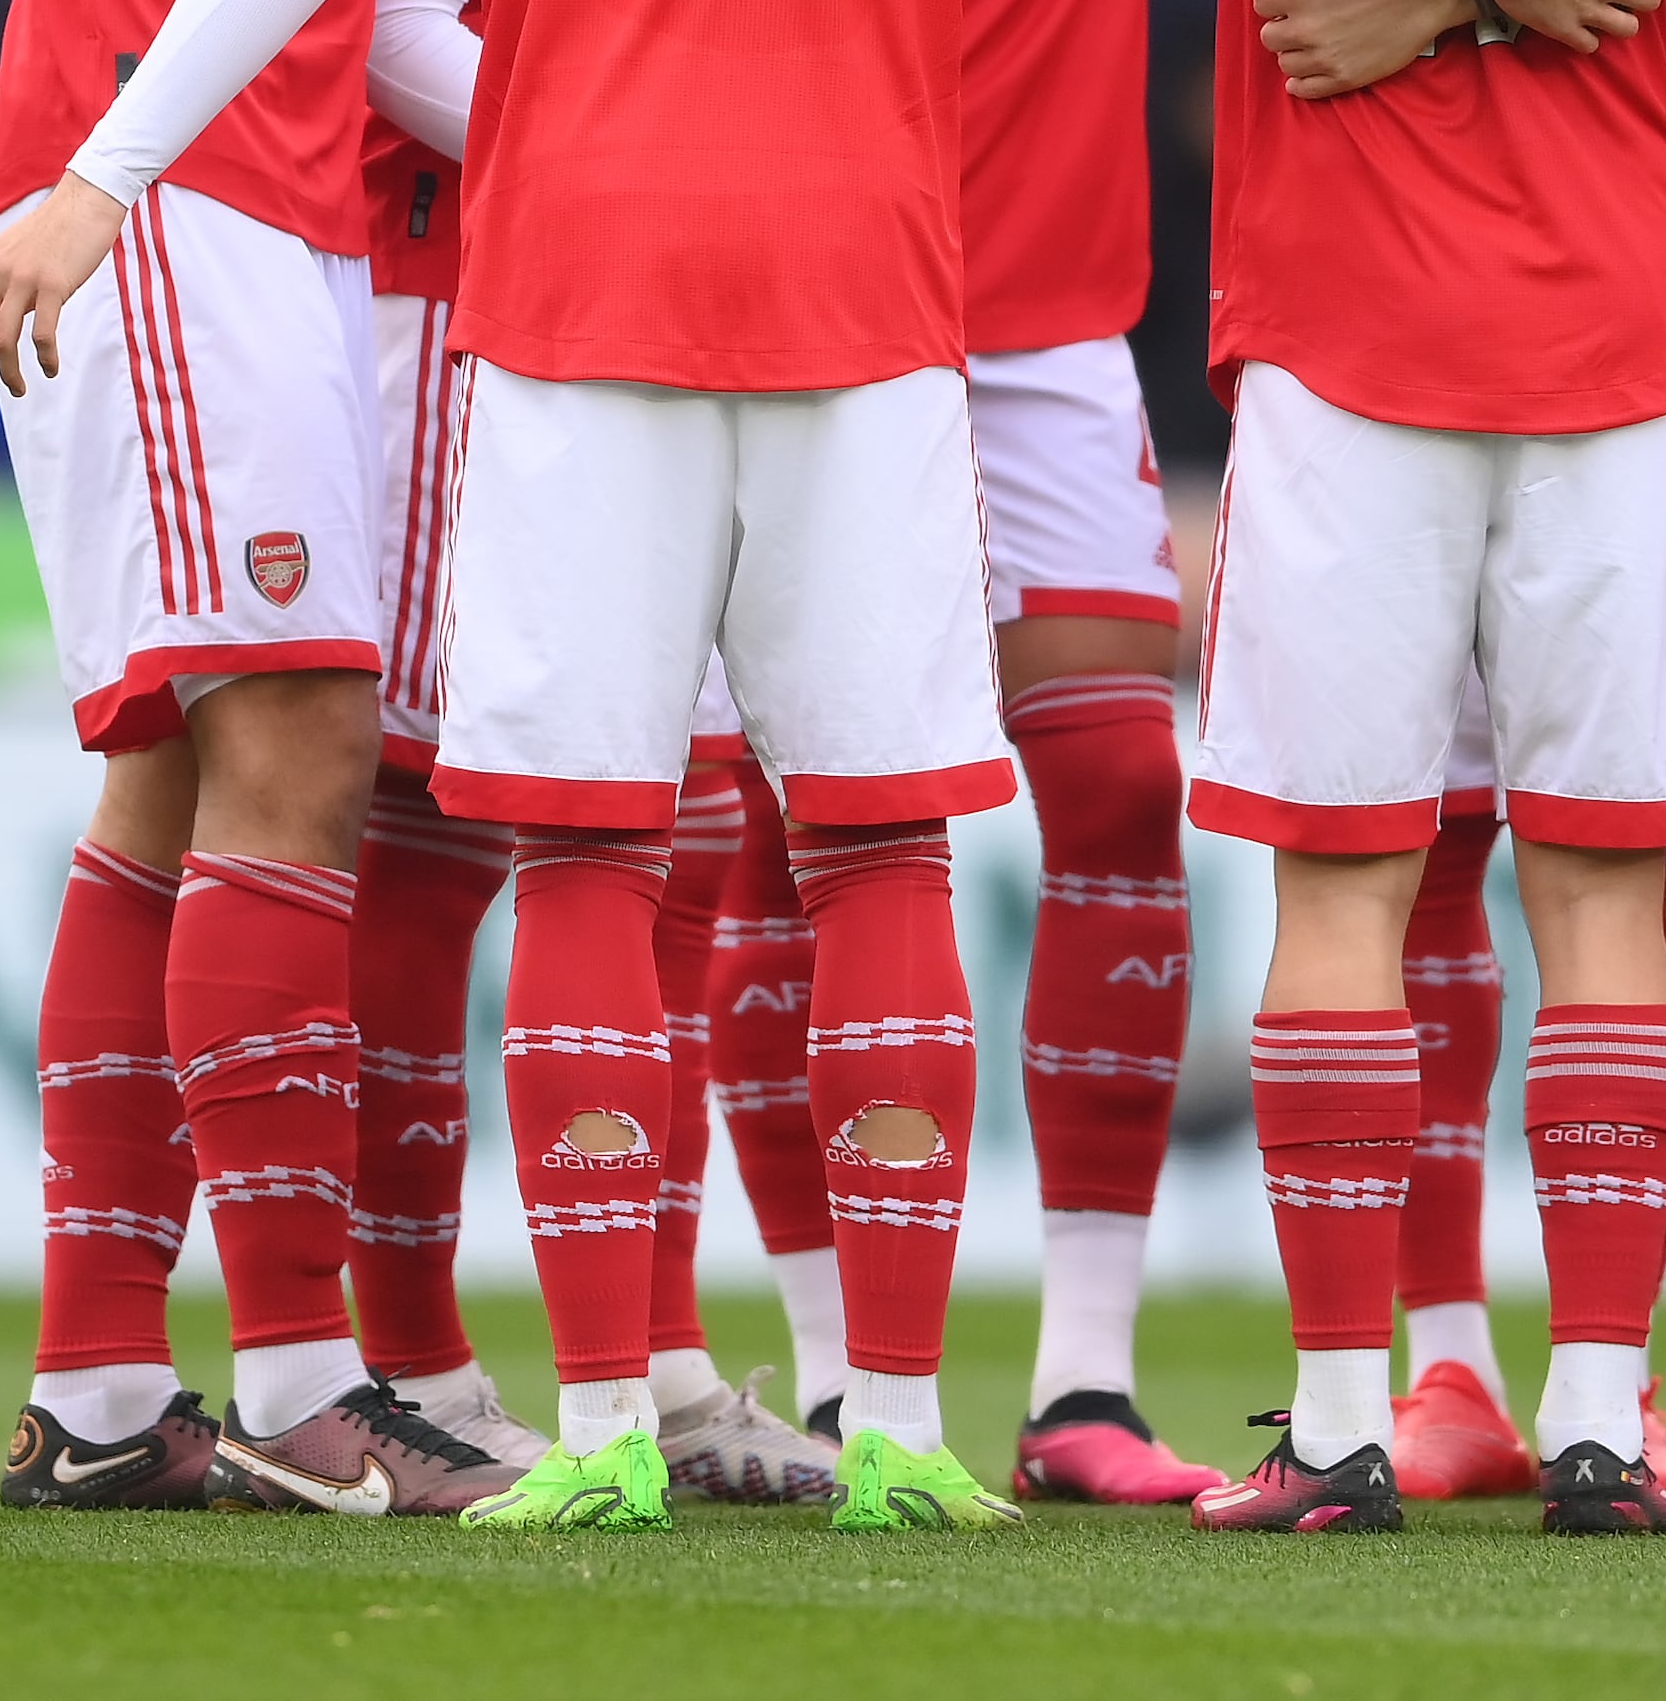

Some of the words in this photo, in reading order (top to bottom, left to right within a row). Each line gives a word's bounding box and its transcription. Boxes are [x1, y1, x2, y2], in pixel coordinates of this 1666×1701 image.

[253, 541, 300, 558] Arsenal
[1105, 952, 1192, 989] AF
[732, 980, 812, 1015] AF
[397, 1117, 469, 1146] AF
[1543, 1124, 1657, 1150] adidas
